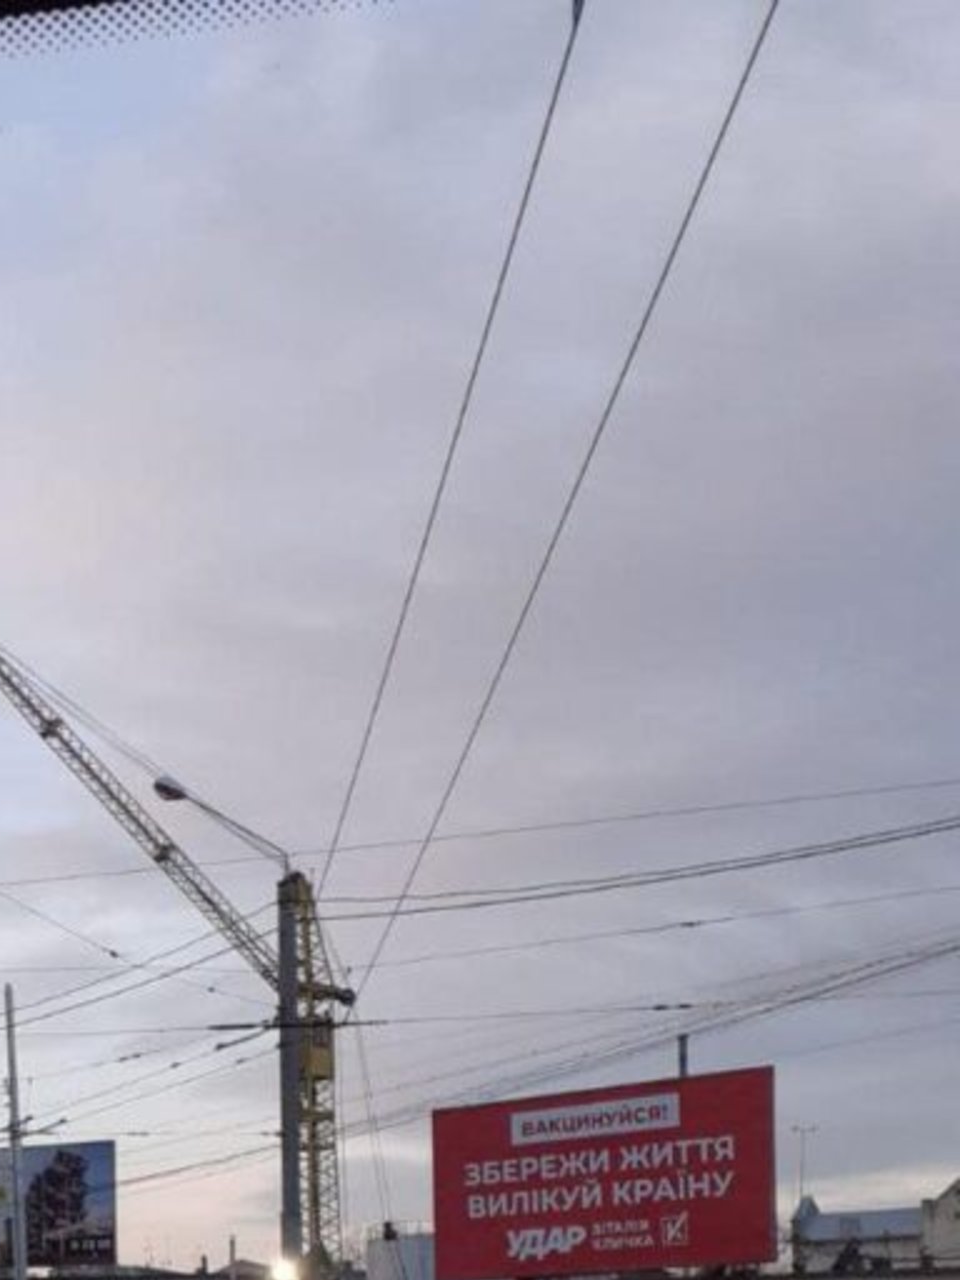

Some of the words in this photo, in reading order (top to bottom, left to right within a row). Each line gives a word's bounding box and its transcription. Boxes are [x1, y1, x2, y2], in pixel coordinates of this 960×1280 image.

[521, 1103, 670, 1138] ВАКЦИНУЙСЯ!
[463, 1149, 610, 1187] ЗБЕРЕЖИ
[619, 1135, 736, 1171] ЖИТТЯ
[468, 1180, 602, 1220] ВИЛІКУЙ
[612, 1169, 735, 1207] КРАЇНУ
[506, 1225, 587, 1261] УДАР
